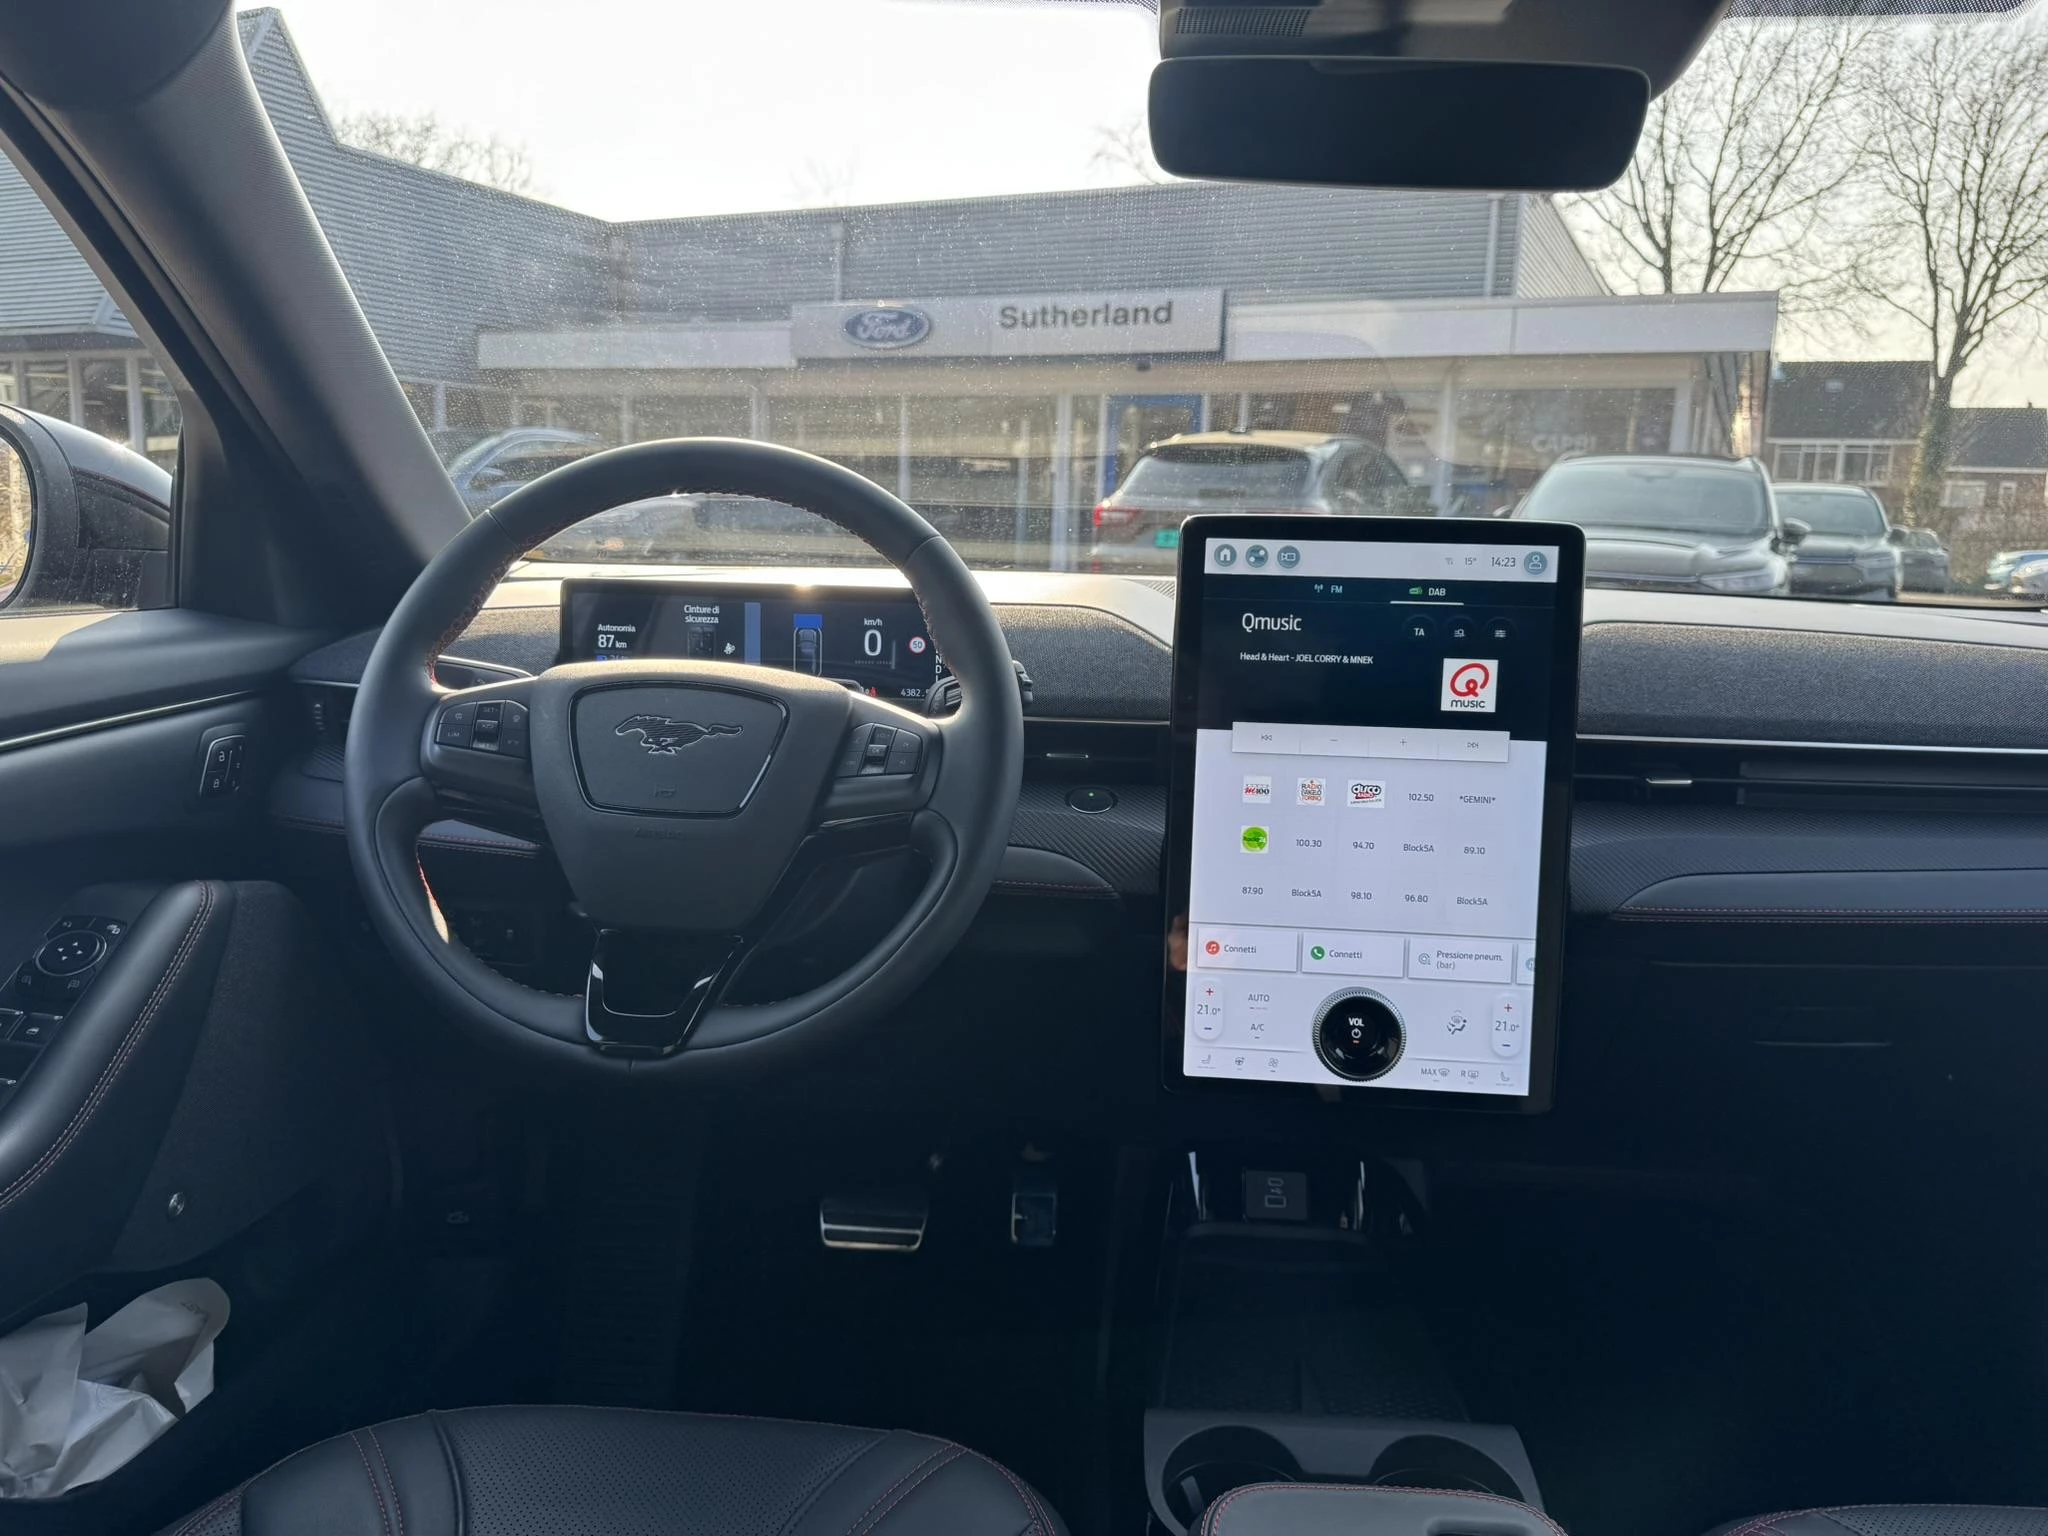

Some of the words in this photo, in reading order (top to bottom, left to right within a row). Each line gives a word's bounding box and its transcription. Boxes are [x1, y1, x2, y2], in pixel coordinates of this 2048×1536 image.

[1000, 302, 1173, 328] Sutherland
[855, 311, 912, 340] Ford
[1491, 557, 1516, 567] 14:23
[1330, 585, 1343, 594] FM
[1428, 587, 1446, 596] DAB
[684, 605, 711, 614] Cinture
[712, 606, 720, 614] di
[685, 615, 719, 624] sicurezza
[864, 618, 882, 626] km/h
[1242, 613, 1302, 632] Qmusic
[597, 624, 636, 633] Autonomia
[1413, 627, 1425, 637] TA
[598, 634, 615, 648] 87
[864, 629, 882, 656] 0
[912, 640, 923, 649] 50
[1240, 652, 1260, 661] Head
[1261, 653, 1268, 661] &
[1268, 653, 1289, 662] Heart
[1295, 654, 1314, 663] JOEL
[1314, 654, 1341, 664] CORRY
[1342, 656, 1349, 664] &
[1350, 655, 1373, 664] MNEK
[935, 665, 942, 673] D
[1408, 793, 1434, 802] 102.50
[1296, 839, 1322, 848] 100.30
[1352, 841, 1375, 850] 94.70
[1463, 847, 1486, 855] 89.10
[1241, 887, 1264, 895] 87.90
[1350, 892, 1372, 900] 98.10
[1404, 894, 1429, 903] 96.80
[1223, 944, 1257, 954] Connetti
[1328, 950, 1363, 959] Connetti
[1436, 950, 1473, 960] Pressione
[1436, 961, 1456, 970] (bar)
[1247, 993, 1270, 1002] AUTO
[1348, 1017, 1365, 1027] VOL
[1250, 1023, 1265, 1032] A/C
[1420, 1067, 1437, 1076] MAX
[1460, 1070, 1466, 1078] R
